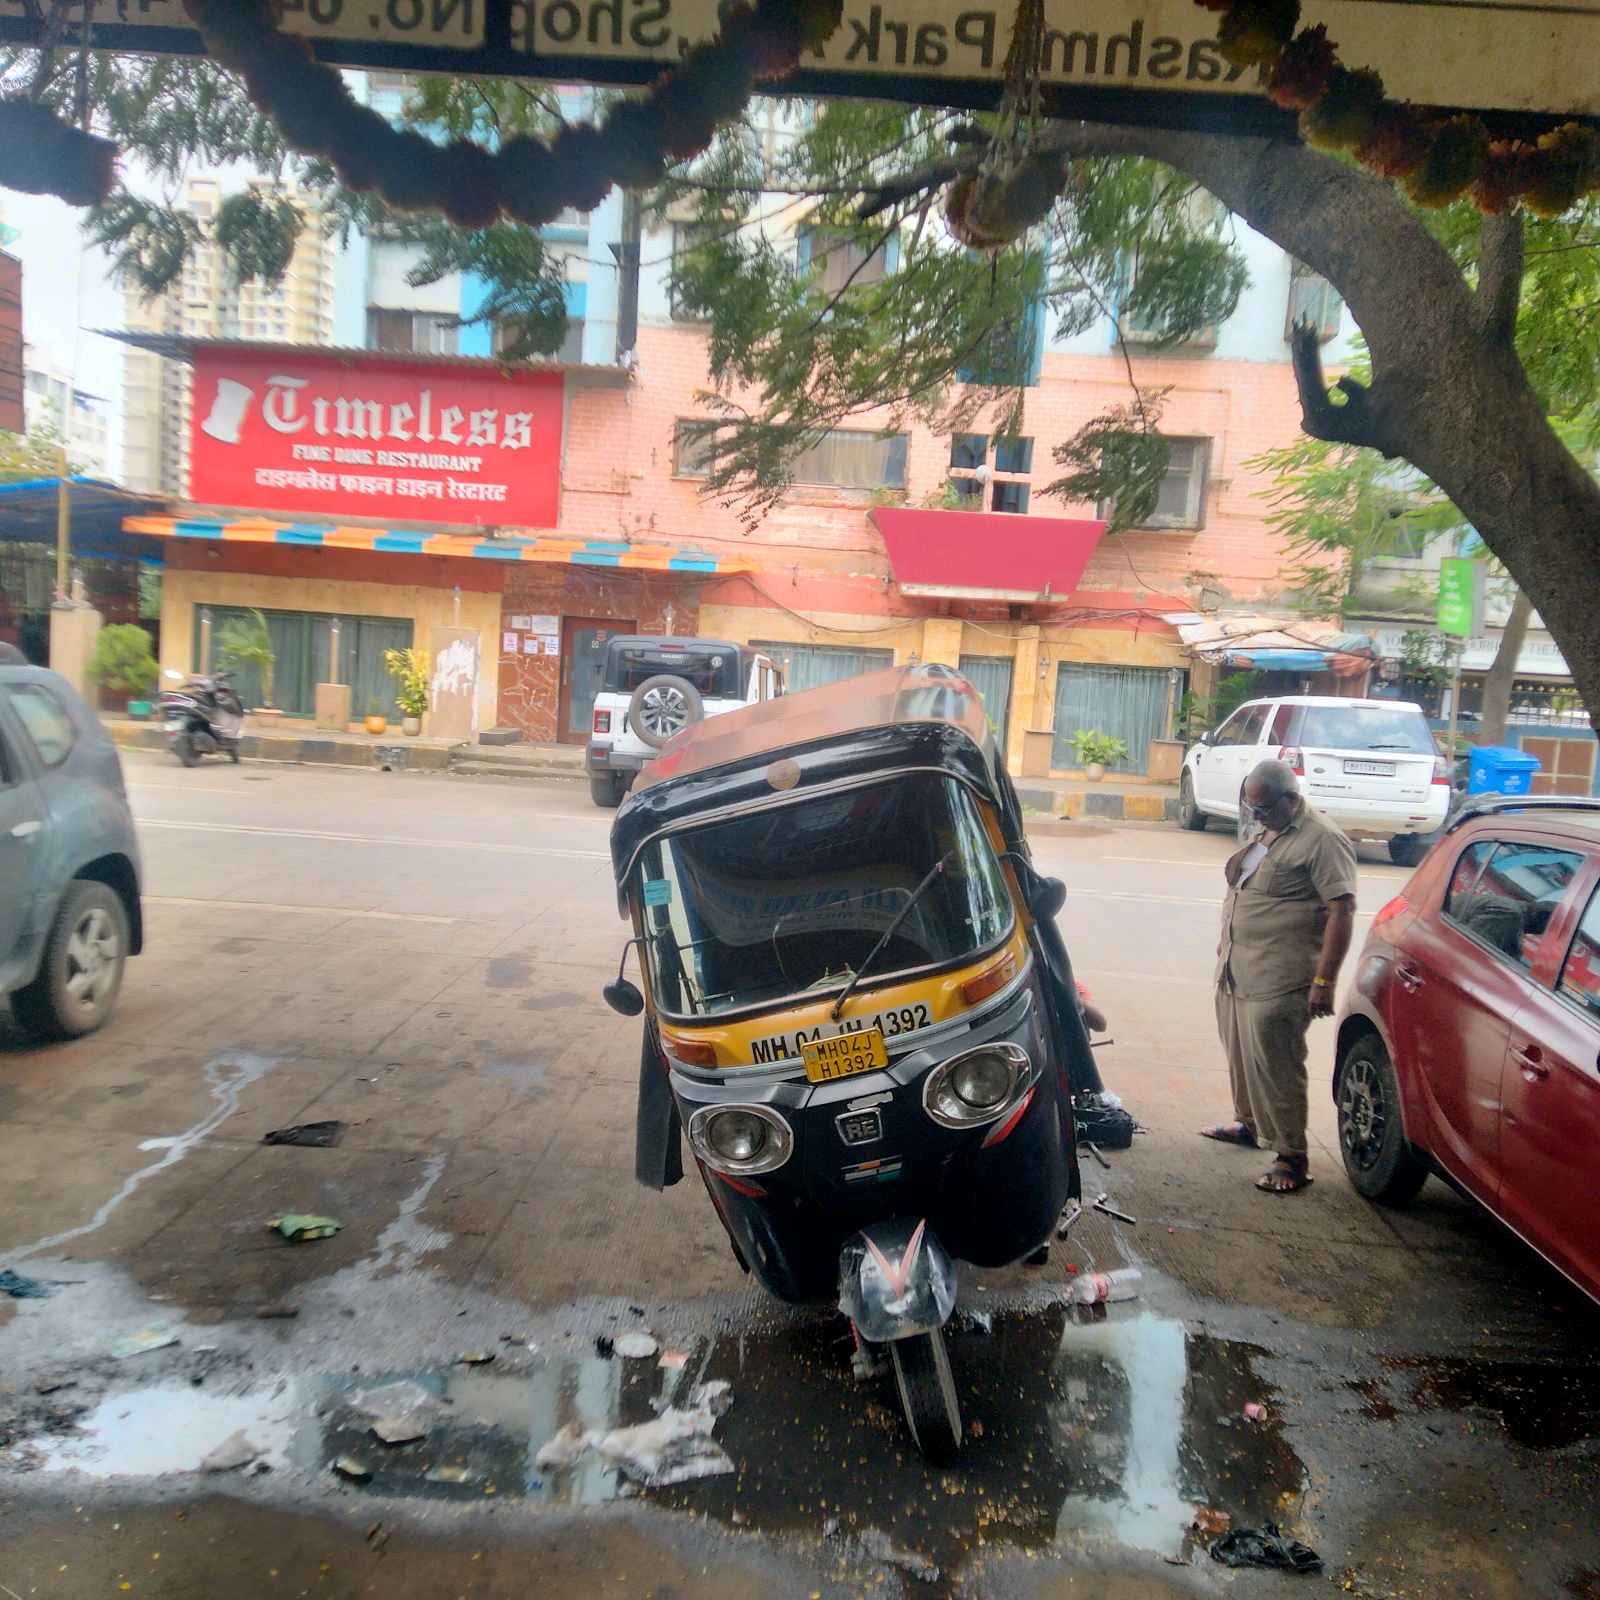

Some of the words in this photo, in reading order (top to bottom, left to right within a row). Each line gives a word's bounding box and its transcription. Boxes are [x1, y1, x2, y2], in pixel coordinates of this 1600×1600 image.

[261, 375, 534, 449] Timeless
[376, 450, 483, 473] RESTAURANT
[873, 1005, 931, 1037] 1392
[817, 1037, 873, 1060] MH04J
[821, 1052, 876, 1079] H1392
